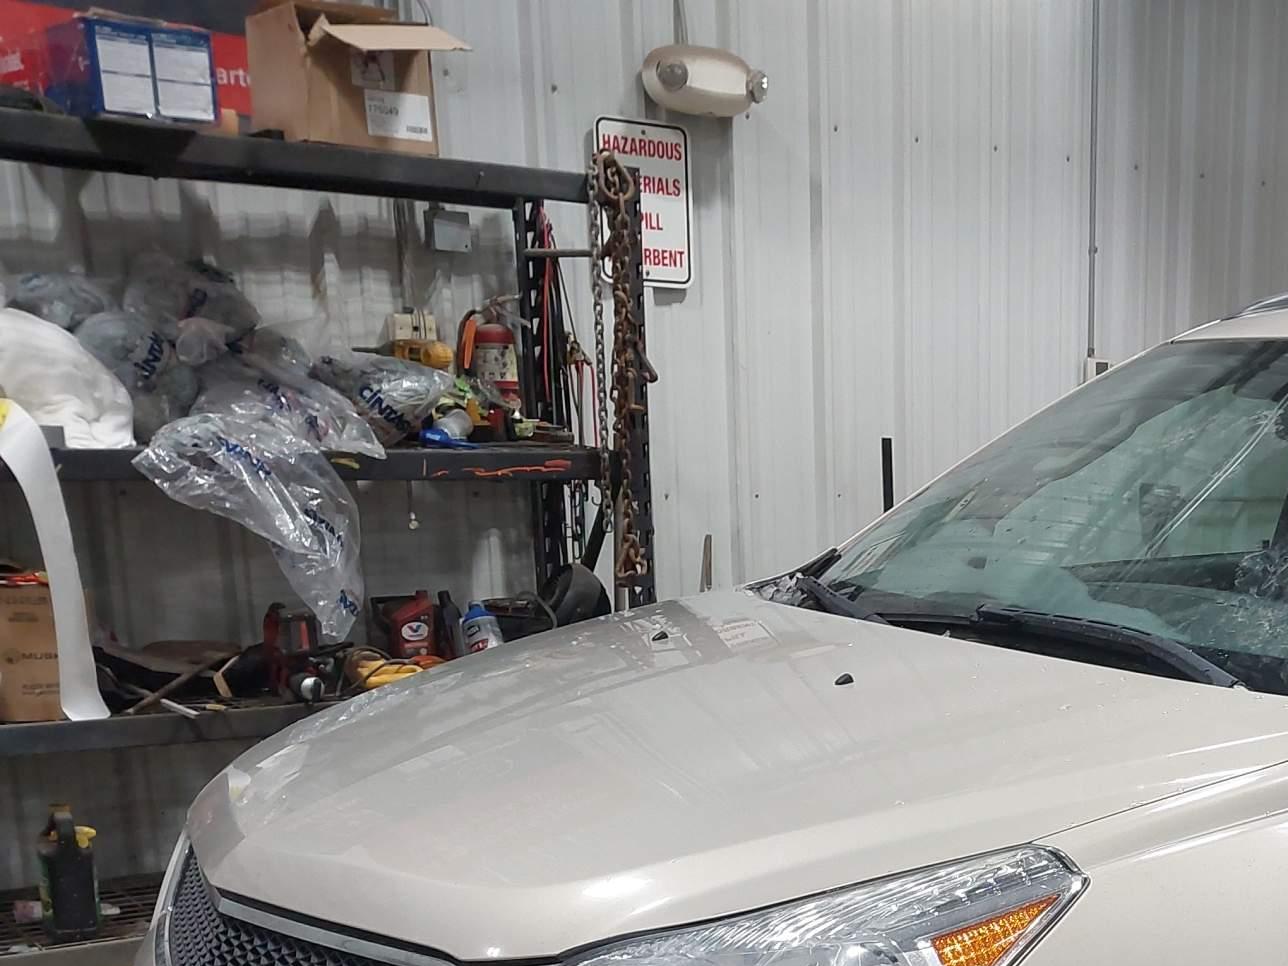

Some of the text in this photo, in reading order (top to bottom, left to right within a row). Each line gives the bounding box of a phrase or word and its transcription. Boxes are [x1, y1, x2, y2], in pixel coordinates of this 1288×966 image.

[602, 133, 682, 161] HAZARDOUS
[640, 175, 681, 197] RIALS
[641, 211, 663, 231] ILL
[643, 248, 685, 268] RBENT
